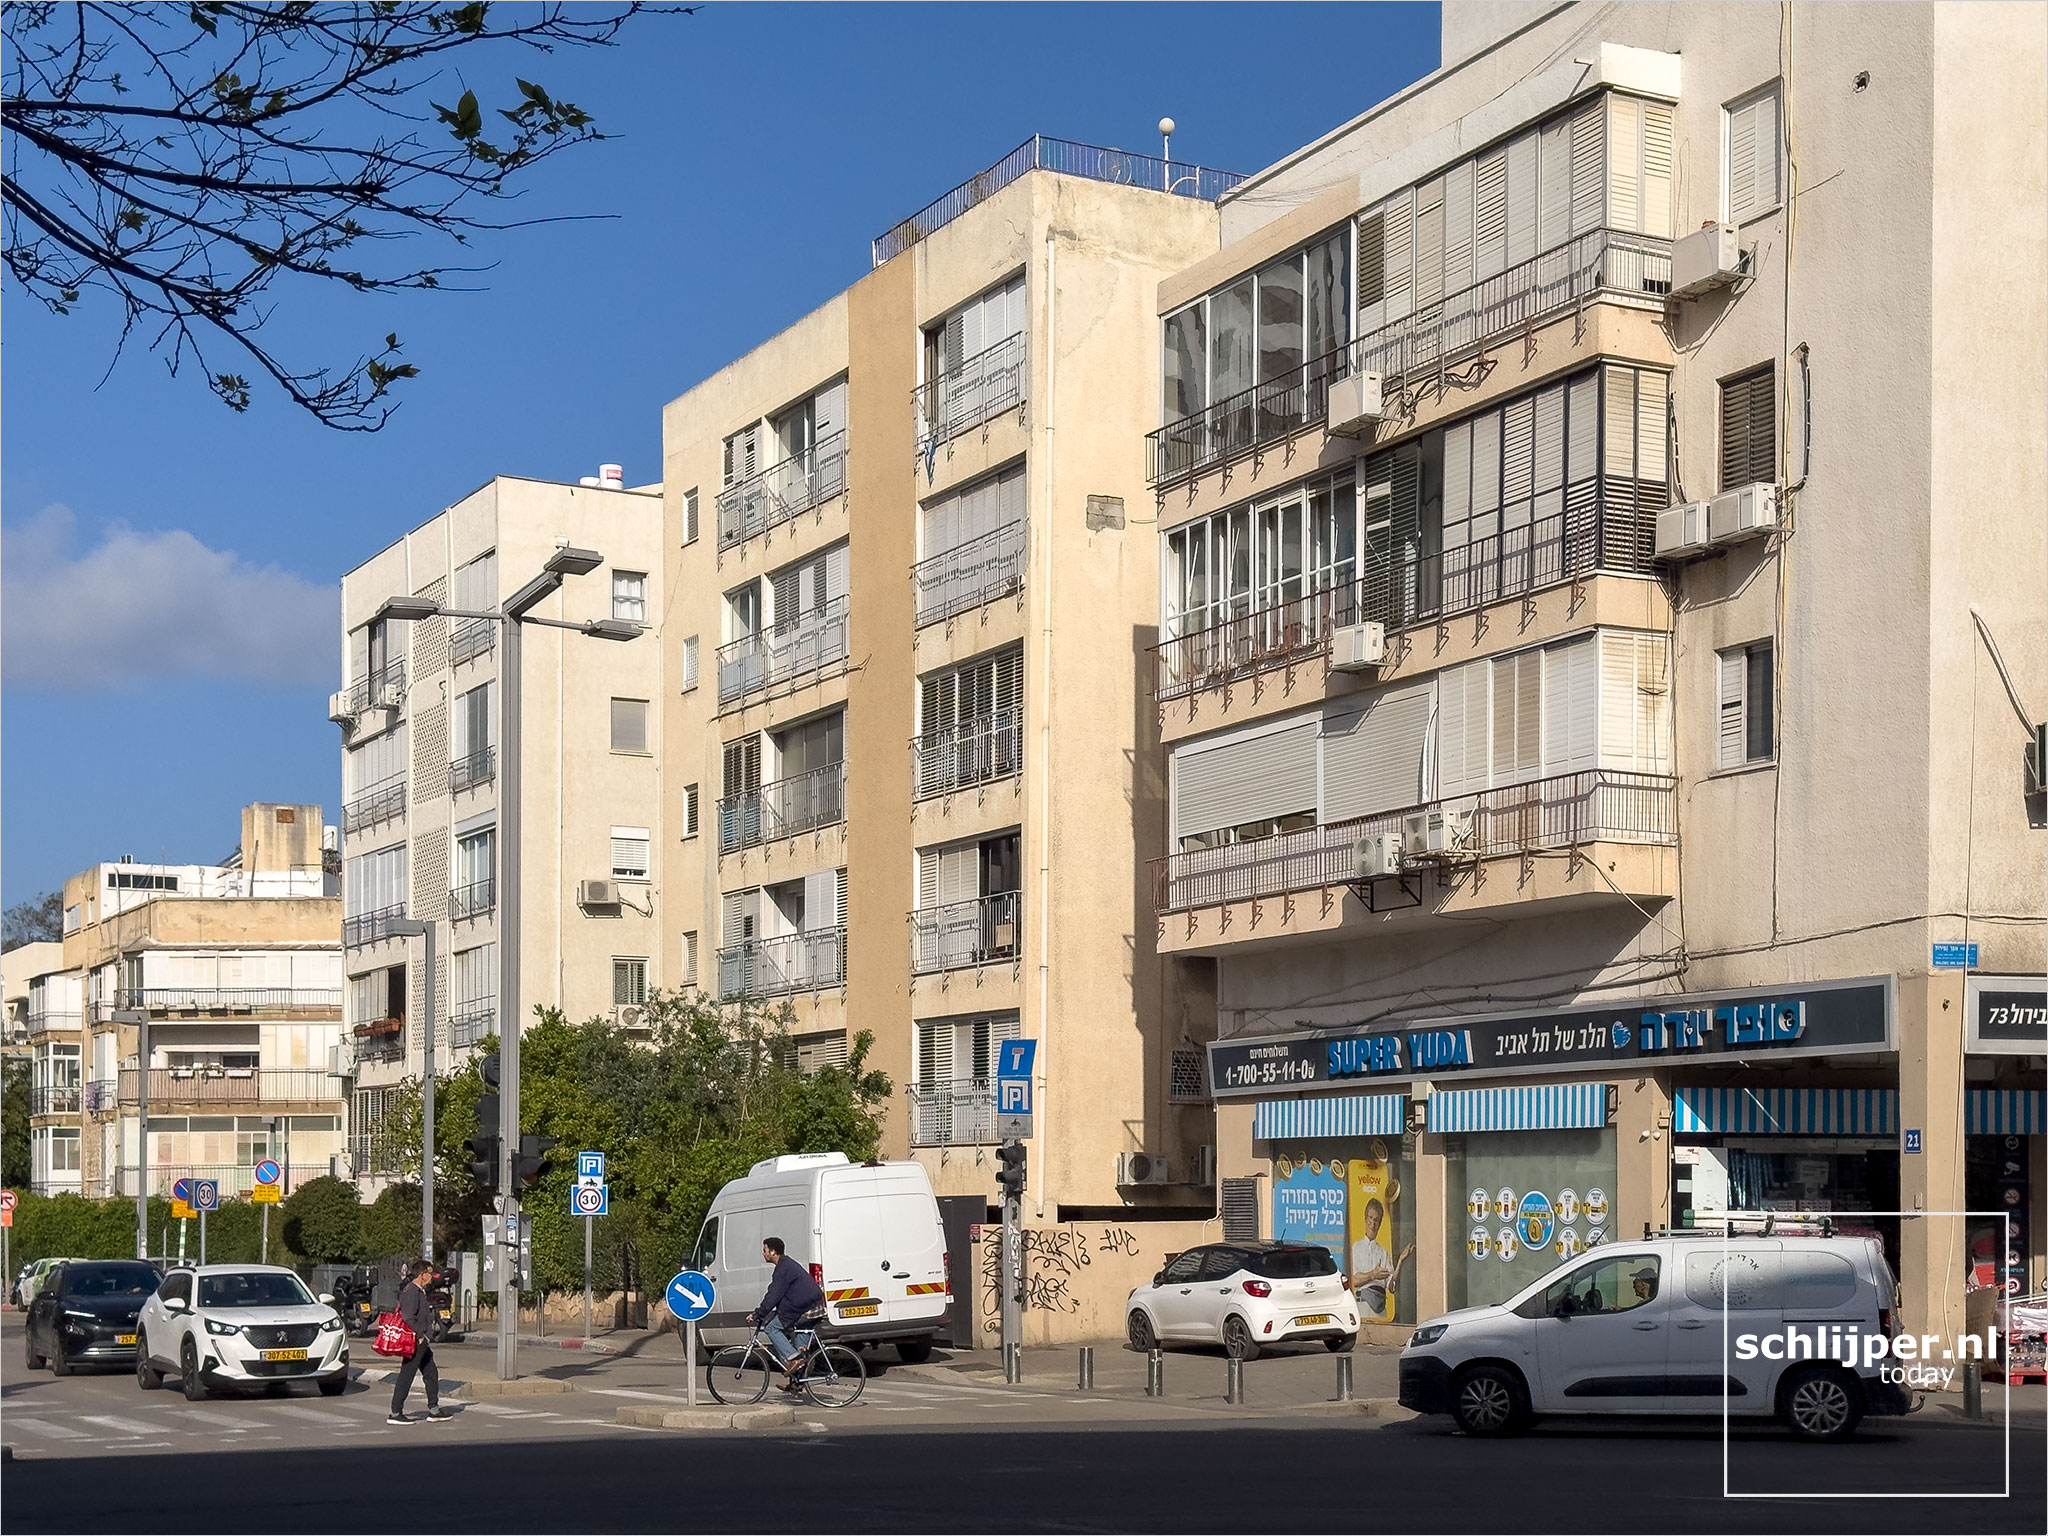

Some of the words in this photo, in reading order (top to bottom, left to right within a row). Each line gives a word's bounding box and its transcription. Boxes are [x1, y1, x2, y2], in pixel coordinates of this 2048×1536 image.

[1716, 1001, 1806, 1044] סופר
[1988, 1007, 2009, 1024] 73
[1554, 1025, 1575, 1051] של
[1578, 1021, 1607, 1049] הלב
[1641, 1008, 1713, 1050] יודה
[1496, 1034, 1528, 1056] אביב
[1532, 1026, 1550, 1053] תל
[1249, 1048, 1263, 1059] חינם
[1263, 1044, 1288, 1058] משלוחים
[1328, 1034, 1402, 1075] SUPER
[1408, 1029, 1474, 1068] YUDA
[1907, 1134, 1919, 1147] 21
[1357, 1174, 1381, 1185] yellow
[201, 1189, 212, 1199] 30
[582, 1195, 598, 1205] 30
[1281, 1188, 1317, 1205] בחזרה
[1320, 1188, 1344, 1208] כסף
[1285, 1206, 1318, 1228] קנייה!
[1321, 1206, 1344, 1226] בכל
